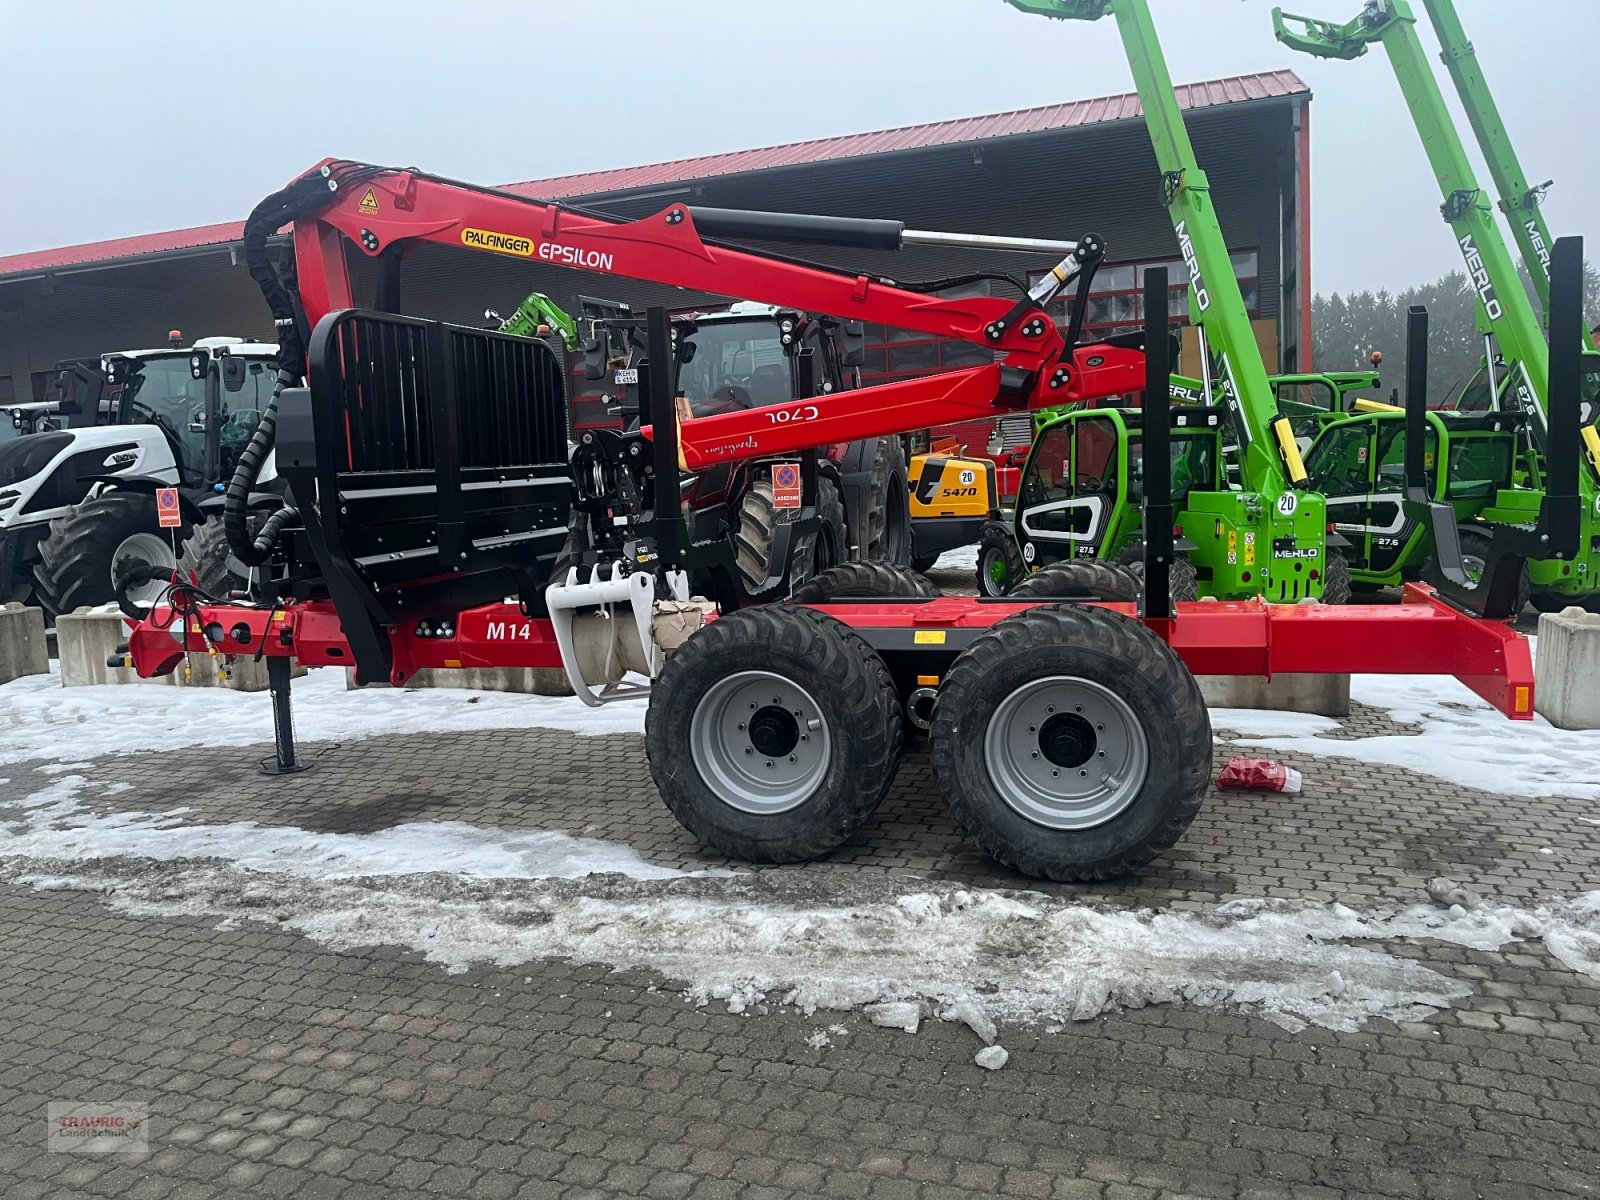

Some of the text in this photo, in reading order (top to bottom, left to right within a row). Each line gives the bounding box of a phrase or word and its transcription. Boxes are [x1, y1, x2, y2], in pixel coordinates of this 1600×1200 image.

[465, 230, 613, 270] PALFINGER EPSILON
[1525, 220, 1551, 283] MERL
[1175, 220, 1210, 311] MERLO
[1460, 233, 1502, 320] MERLO
[1222, 379, 1238, 412] 27.6
[1518, 385, 1536, 416] 27.6
[765, 406, 819, 424] C70L
[962, 472, 972, 482] 20
[943, 487, 977, 497] 5470
[1280, 495, 1294, 511] 20
[1025, 546, 1034, 559] 20
[1275, 549, 1317, 558] MERLO
[486, 622, 531, 640] M14
